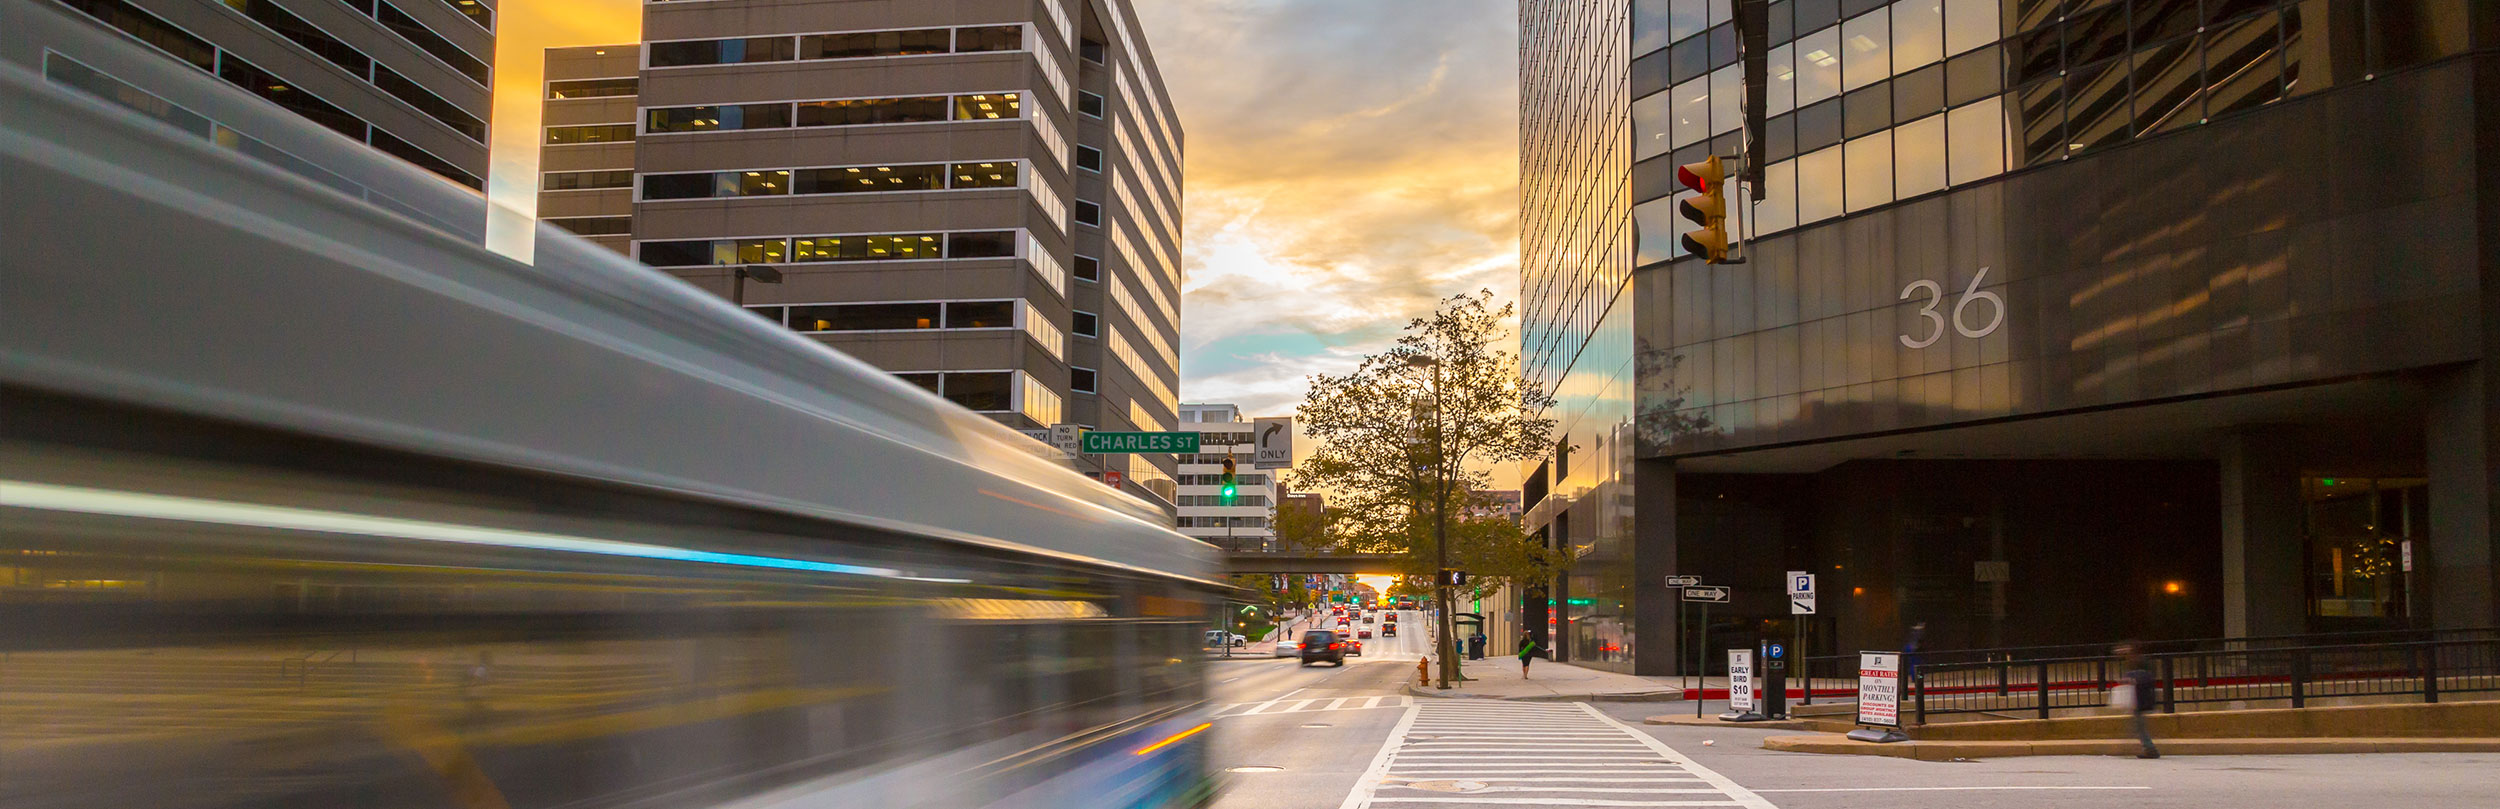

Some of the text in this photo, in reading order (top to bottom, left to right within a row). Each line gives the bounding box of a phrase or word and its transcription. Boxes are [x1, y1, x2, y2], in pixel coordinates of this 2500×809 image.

[1899, 265, 2005, 349] 36
[1089, 434, 1193, 450] CHARLES ST
[1260, 450, 1286, 459] ONLY
[1798, 577, 1808, 590] P
[1792, 592, 1814, 600] PARKING
[1773, 646, 1780, 656] P
[1734, 685, 1748, 694] $10
[1863, 685, 1895, 693] MONTHLY
[1863, 693, 1895, 702] PARKING!
